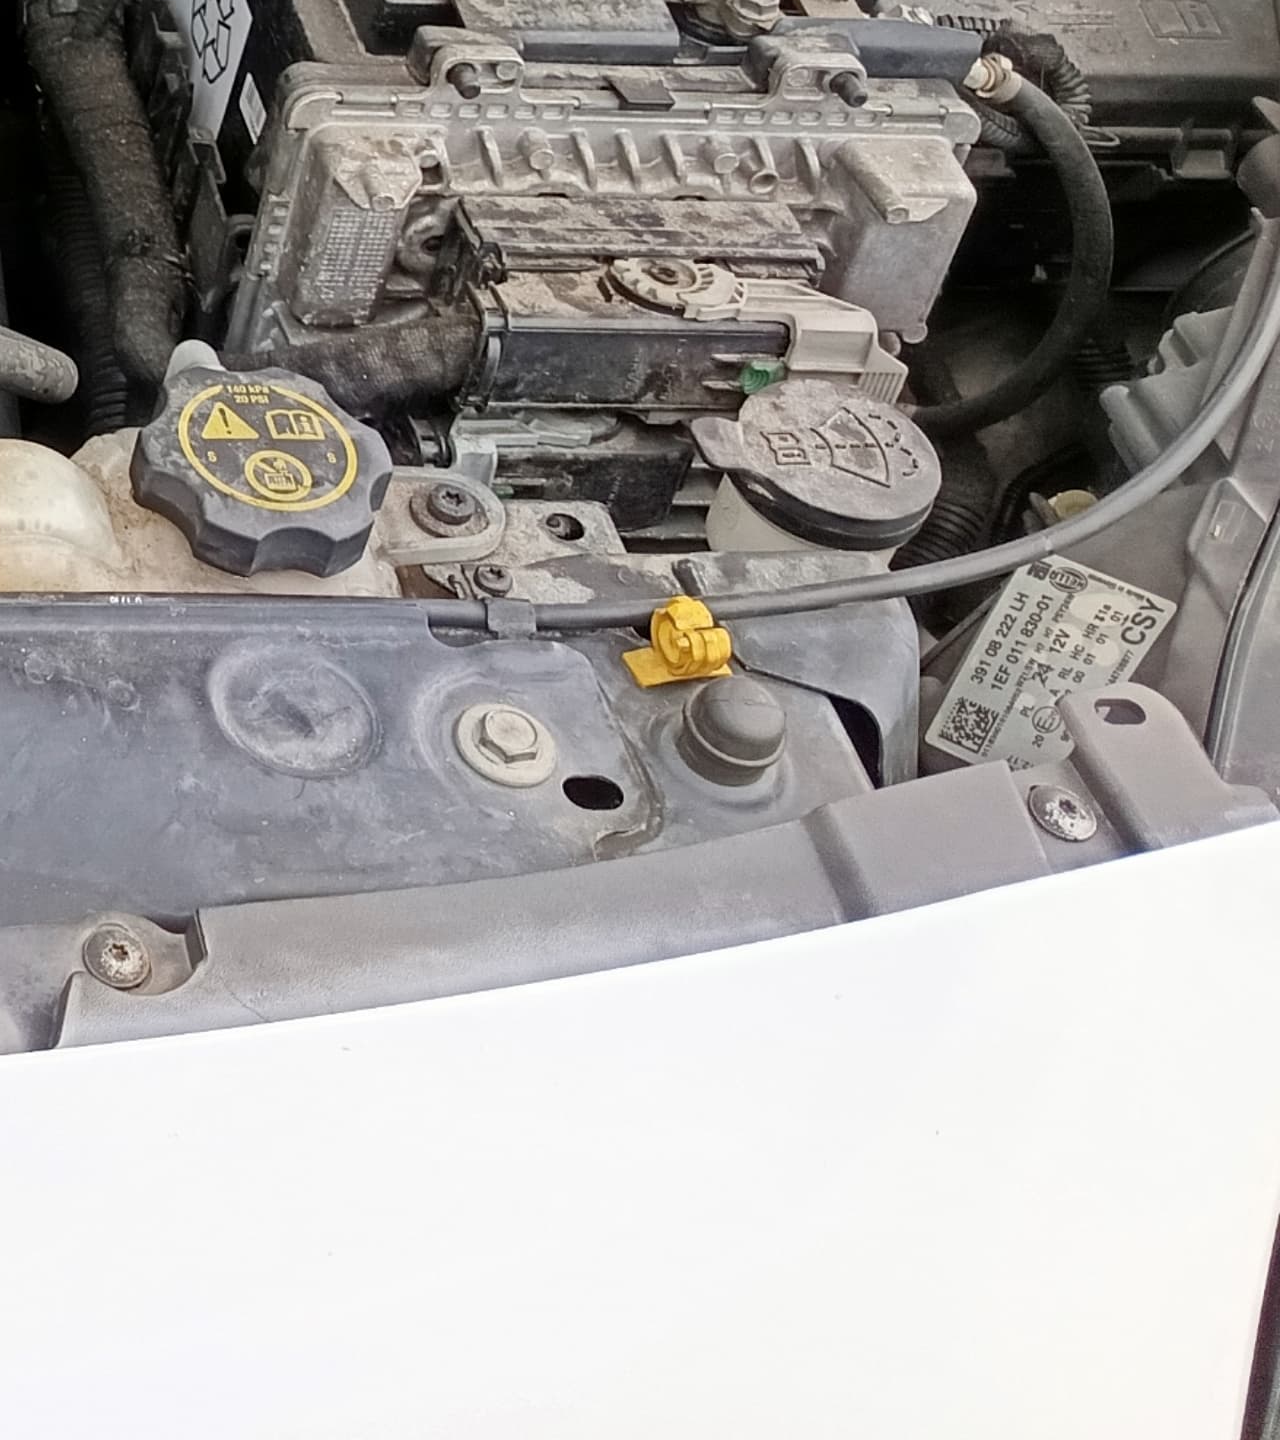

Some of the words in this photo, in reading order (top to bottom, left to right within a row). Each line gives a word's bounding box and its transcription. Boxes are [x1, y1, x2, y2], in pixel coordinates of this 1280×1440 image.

[971, 660, 991, 684] 391
[985, 640, 1002, 657] 08
[996, 614, 1017, 638] 222
[1010, 592, 1029, 612] LH
[991, 664, 1010, 690] 1EF
[1006, 640, 1027, 664] 011
[1020, 595, 1053, 638] 830-01
[1049, 629, 1070, 654] 12V
[1121, 595, 1165, 645] CSY
